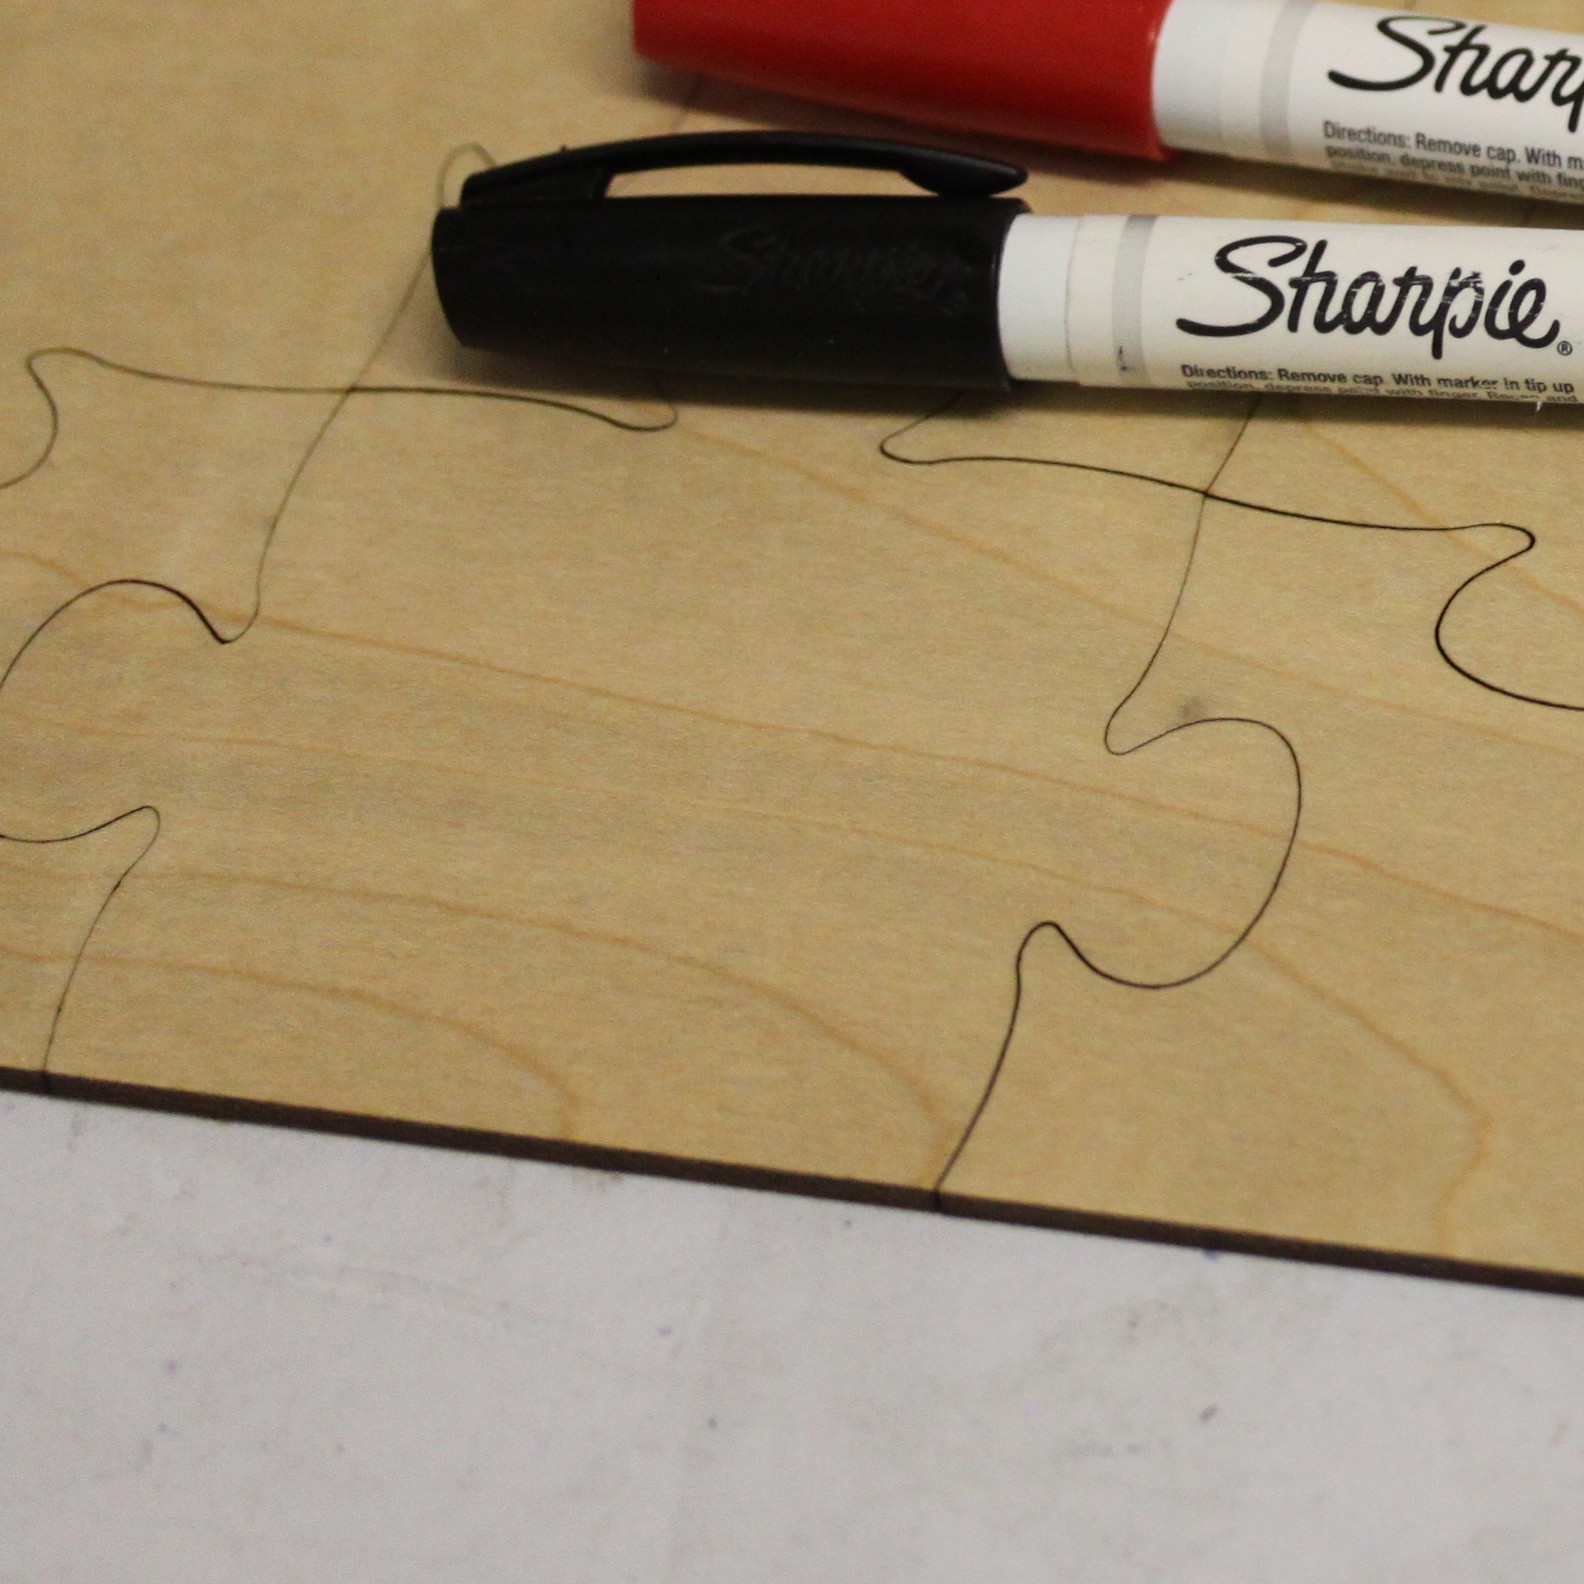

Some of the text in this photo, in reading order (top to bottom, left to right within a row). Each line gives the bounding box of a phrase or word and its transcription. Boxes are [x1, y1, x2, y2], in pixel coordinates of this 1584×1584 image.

[1323, 120, 1411, 149] Directions:
[1415, 132, 1482, 158] Remove
[1487, 145, 1521, 166] cap.
[1525, 146, 1563, 169] With
[1398, 153, 1466, 177] depress
[1469, 164, 1512, 182] point
[1516, 167, 1552, 186] with
[1175, 234, 1561, 361] Sharpie
[1181, 363, 1274, 383] Directions:
[1277, 367, 1348, 386] Remove
[1393, 371, 1432, 389] With
[1436, 374, 1500, 393] marker
[1523, 378, 1548, 395] tip
[1552, 381, 1575, 397] up
